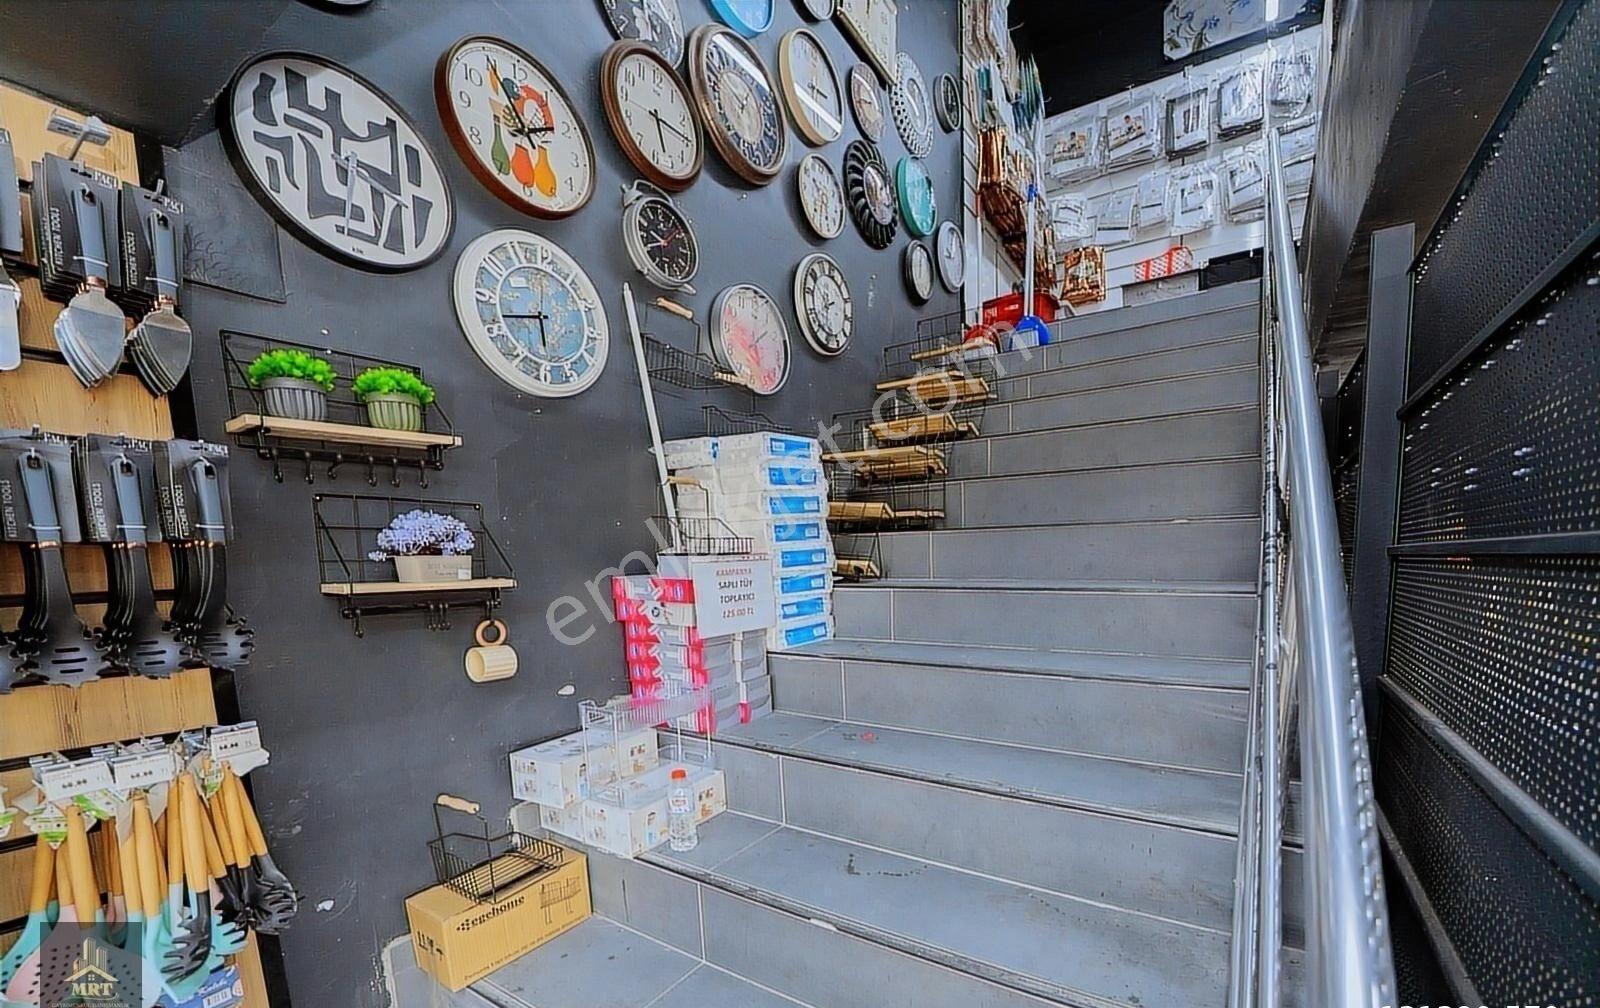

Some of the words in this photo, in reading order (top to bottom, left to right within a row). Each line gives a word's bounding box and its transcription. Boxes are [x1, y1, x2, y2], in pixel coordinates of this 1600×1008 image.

[464, 64, 483, 87] 10
[459, 91, 472, 109] 9
[469, 126, 483, 146] 8
